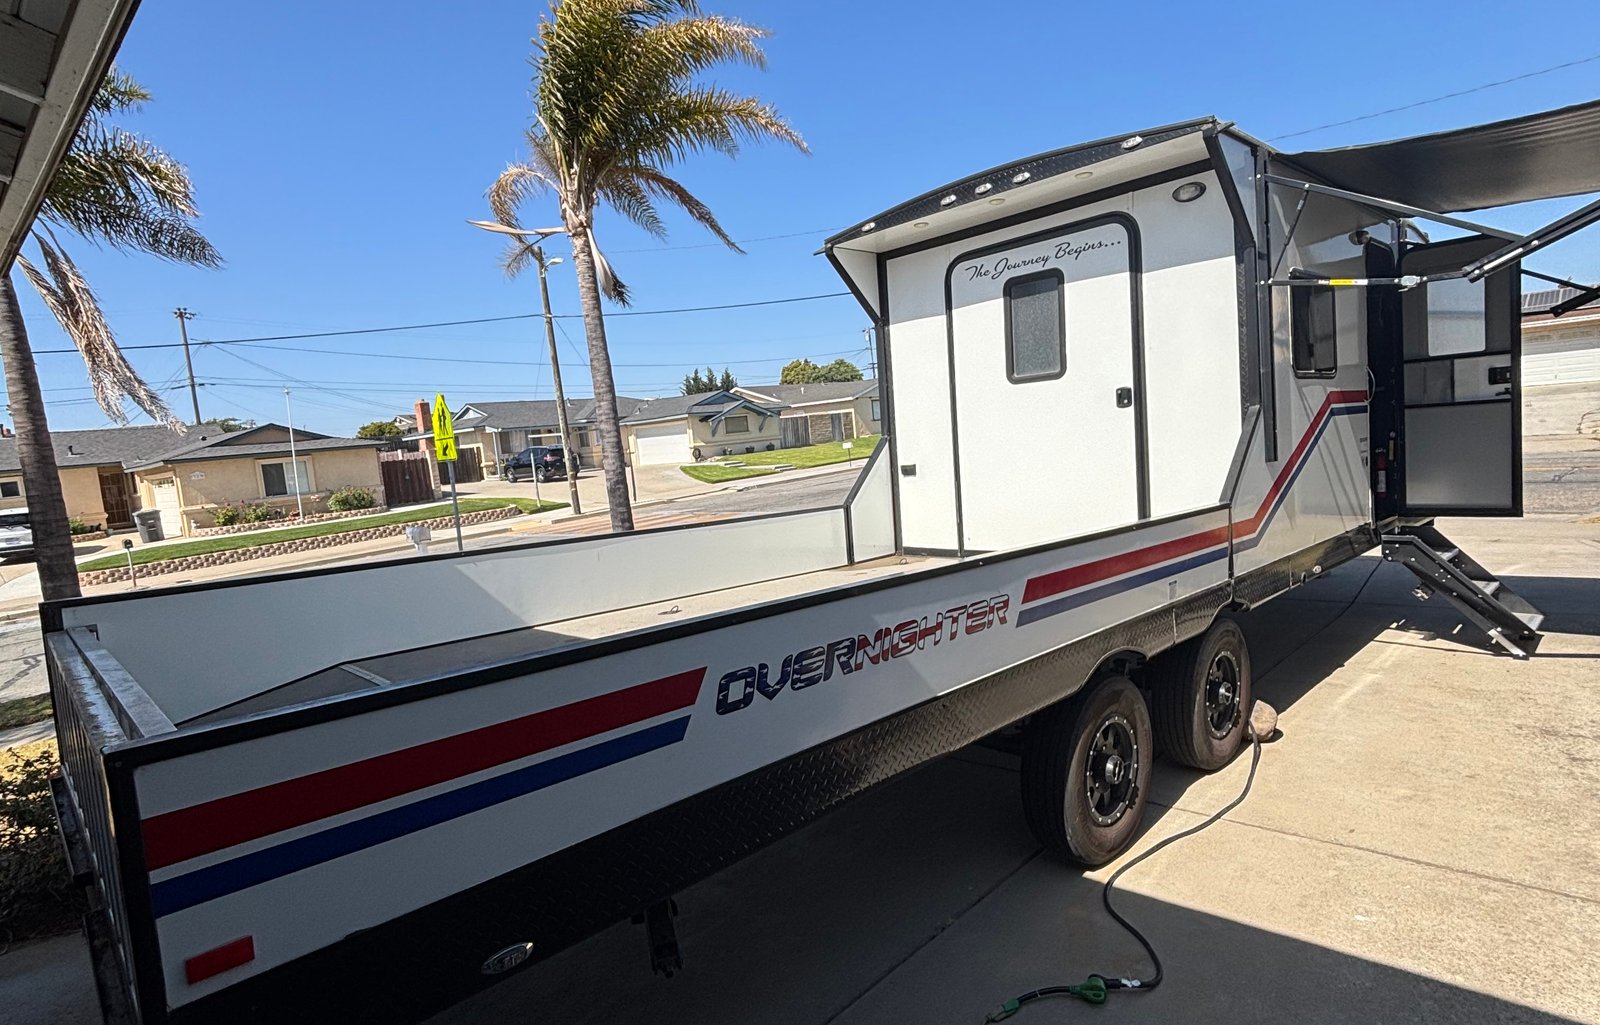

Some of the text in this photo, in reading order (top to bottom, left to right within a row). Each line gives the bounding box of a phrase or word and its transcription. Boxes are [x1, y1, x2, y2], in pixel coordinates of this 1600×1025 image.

[965, 240, 1121, 281] The Journey Begins...
[715, 593, 1010, 716] OVERNIGHTER
